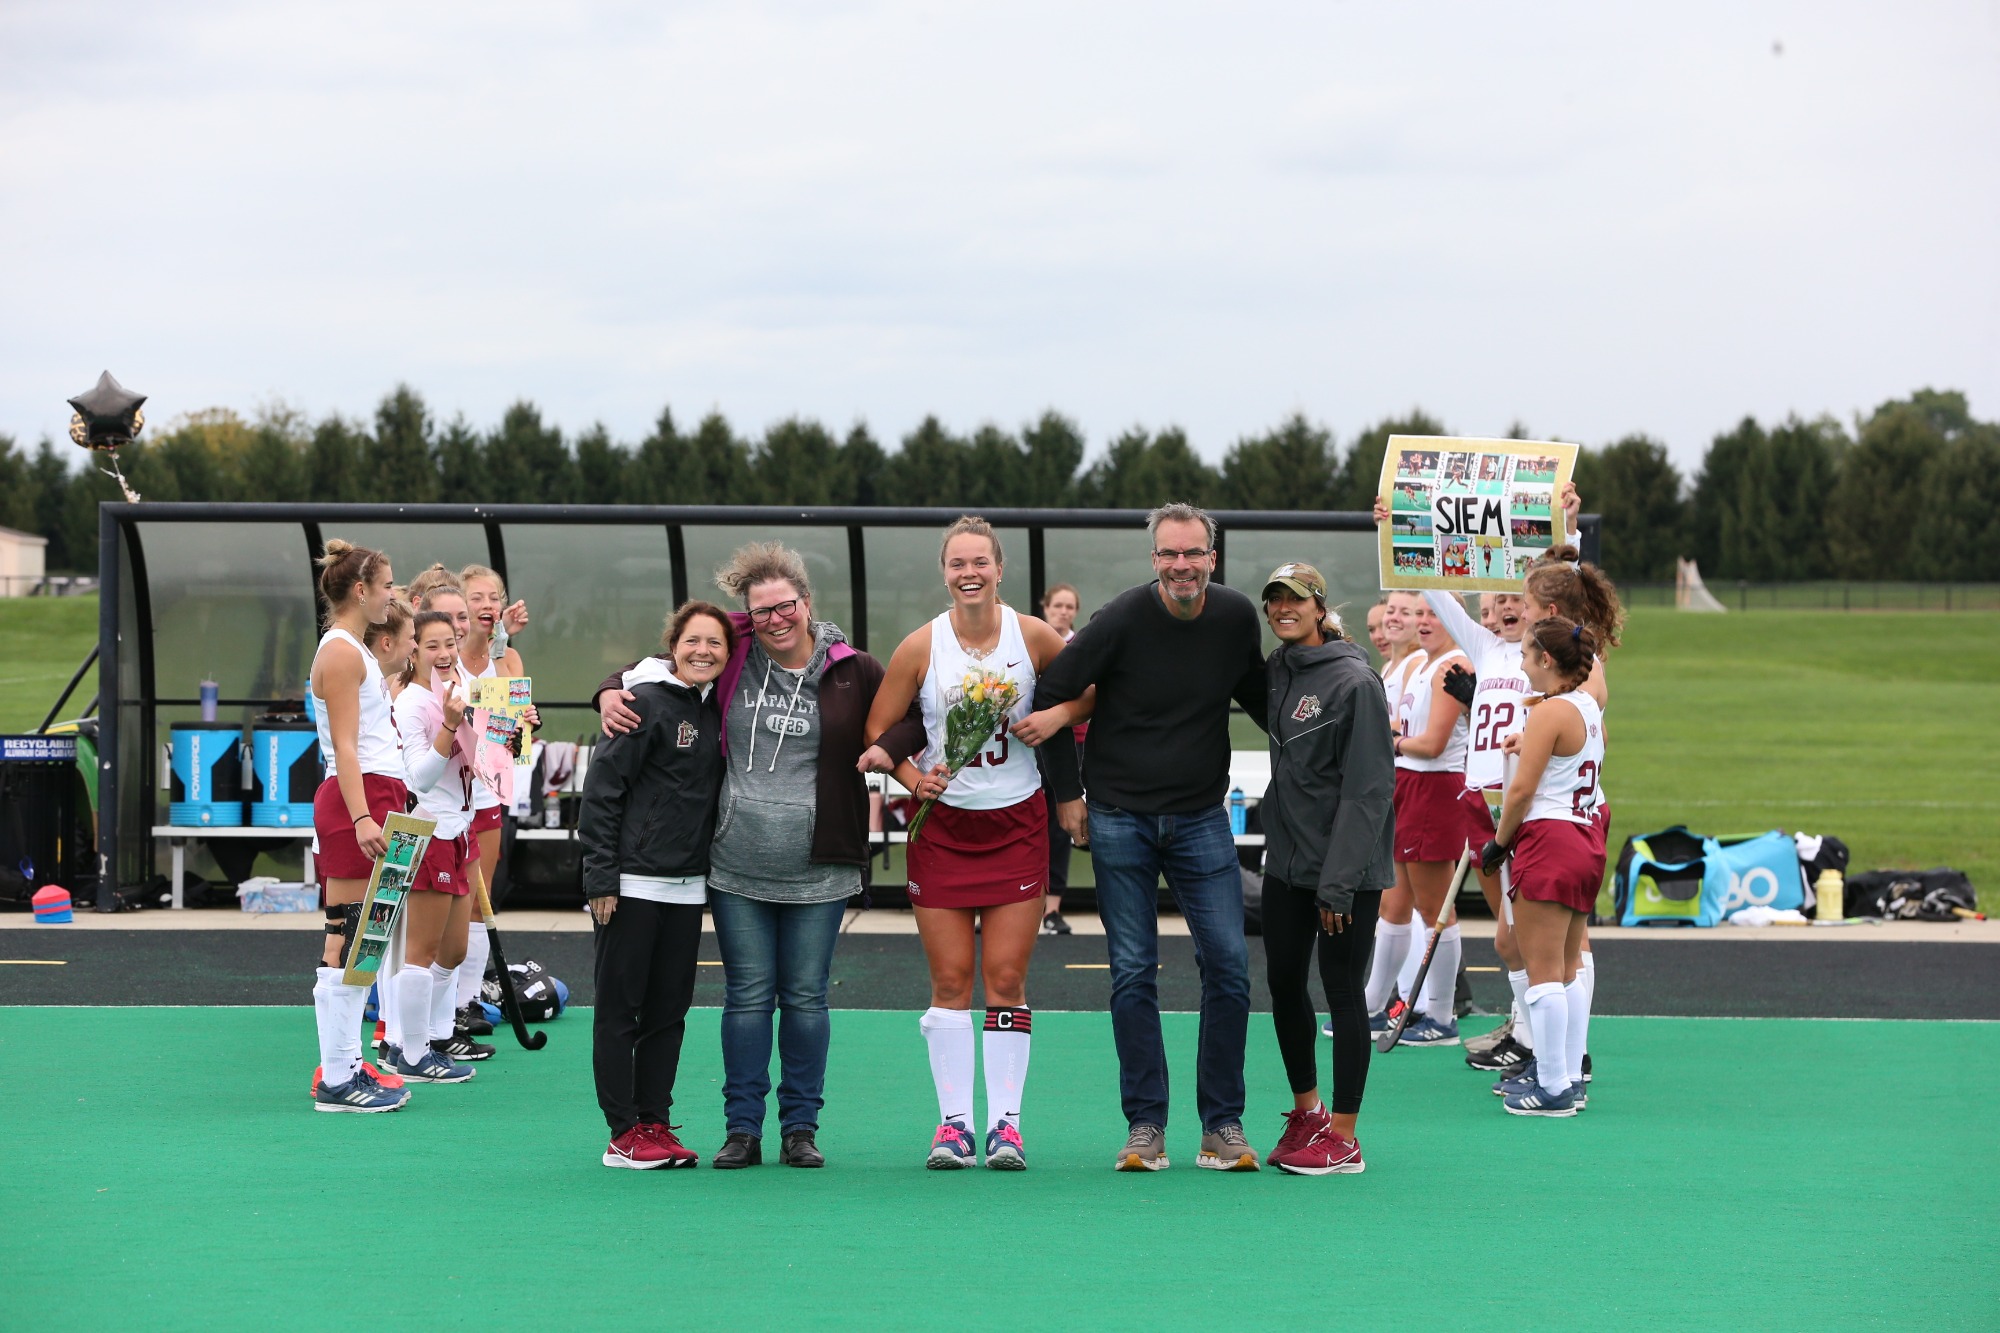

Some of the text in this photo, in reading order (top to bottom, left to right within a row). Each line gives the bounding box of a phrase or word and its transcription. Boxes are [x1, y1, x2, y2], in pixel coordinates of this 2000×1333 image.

[1435, 496, 1505, 536] SIEM
[771, 716, 804, 734] 1826
[1474, 702, 1515, 752] 22
[191, 734, 200, 801] POWERADE
[269, 735, 279, 801] POWERADE
[1572, 760, 1602, 821] 2
[998, 1012, 1012, 1029] C
